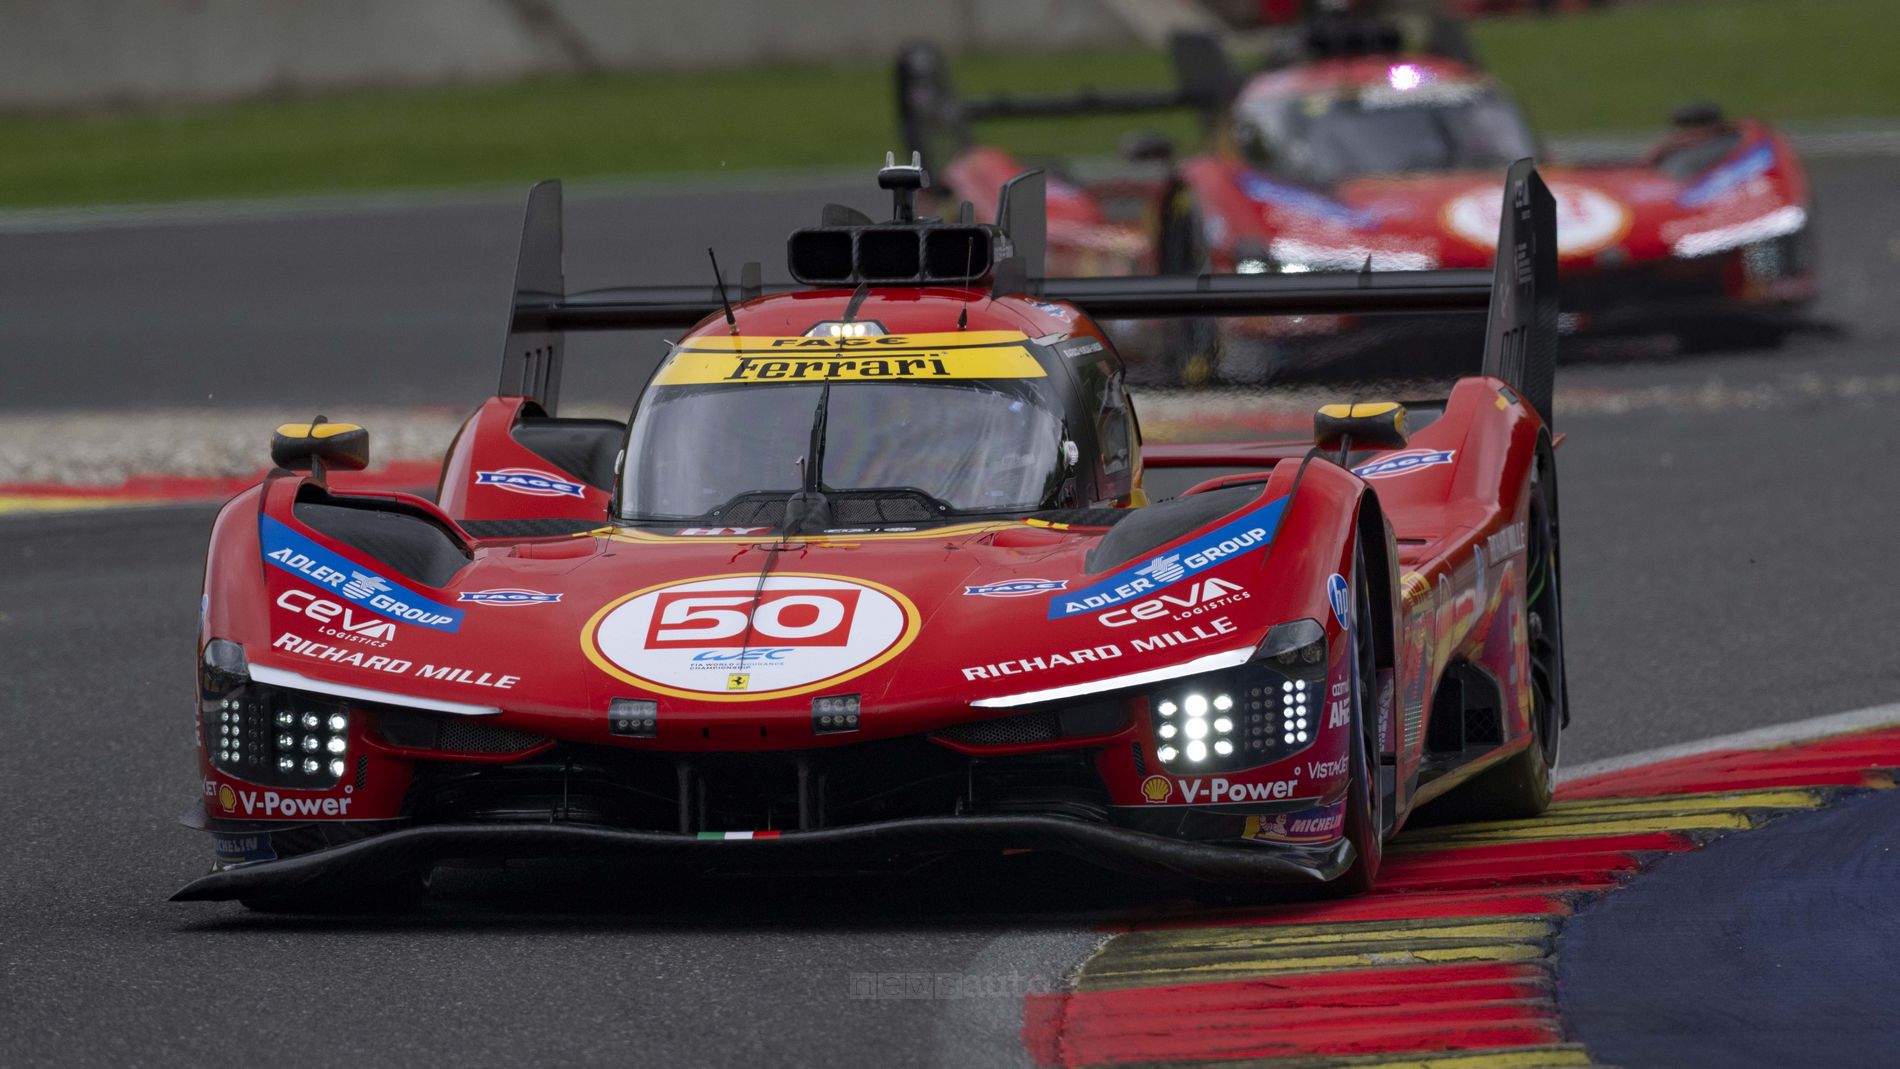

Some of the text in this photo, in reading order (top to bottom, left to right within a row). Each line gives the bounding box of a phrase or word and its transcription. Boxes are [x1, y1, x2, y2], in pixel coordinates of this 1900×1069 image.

[772, 337, 909, 347] FAGE
[723, 353, 951, 380] Ferrari
[1362, 455, 1441, 474] FAGE
[491, 475, 573, 492] FAGE
[1065, 527, 1267, 614] ADLER GROUP
[267, 547, 453, 627] ADLER GROUP
[978, 583, 1055, 593] FAGE
[656, 595, 845, 641] 50
[1173, 591, 1251, 621] LOGISTICS
[318, 626, 388, 648] LOGISTICS
[961, 616, 1238, 681] RICHARD MILLE
[273, 632, 521, 689] RICHARD MILLE
[692, 648, 795, 661] WEC
[1178, 778, 1298, 802] V-Power
[239, 791, 352, 817] V-Power
